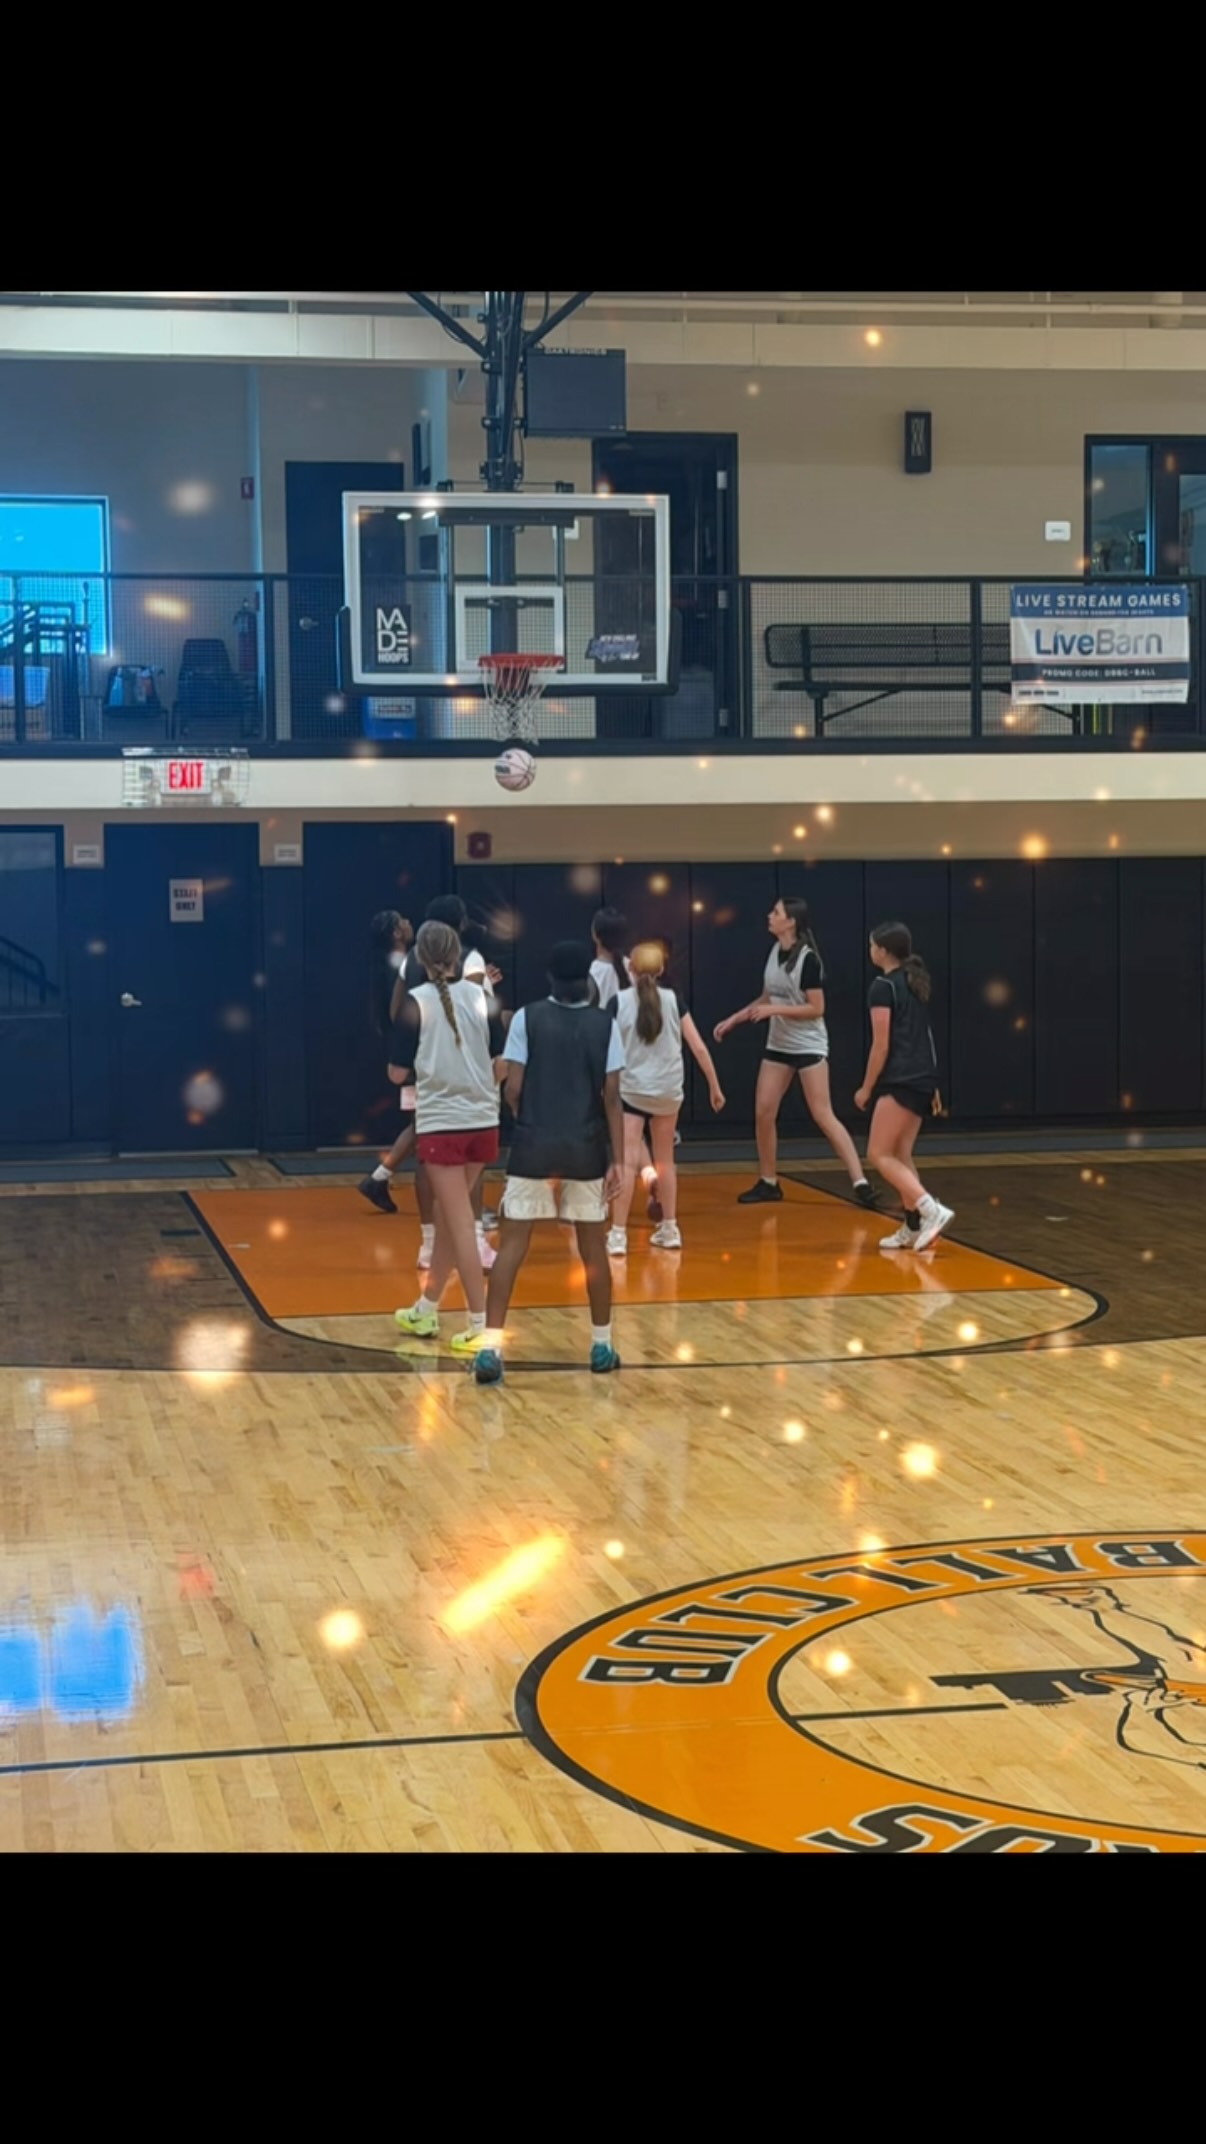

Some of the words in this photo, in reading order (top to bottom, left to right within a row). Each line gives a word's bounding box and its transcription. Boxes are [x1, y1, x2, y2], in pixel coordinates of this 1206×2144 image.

[1016, 594, 1051, 607] LIVE
[1057, 594, 1122, 608] STREAM
[1127, 593, 1182, 607] GAMES
[1034, 627, 1163, 656] LiveBarn
[1042, 668, 1073, 678] PROMO
[169, 761, 204, 789] EXIT
[800, 1540, 1206, 1592] BALL
[577, 1584, 860, 1687] CLUB
